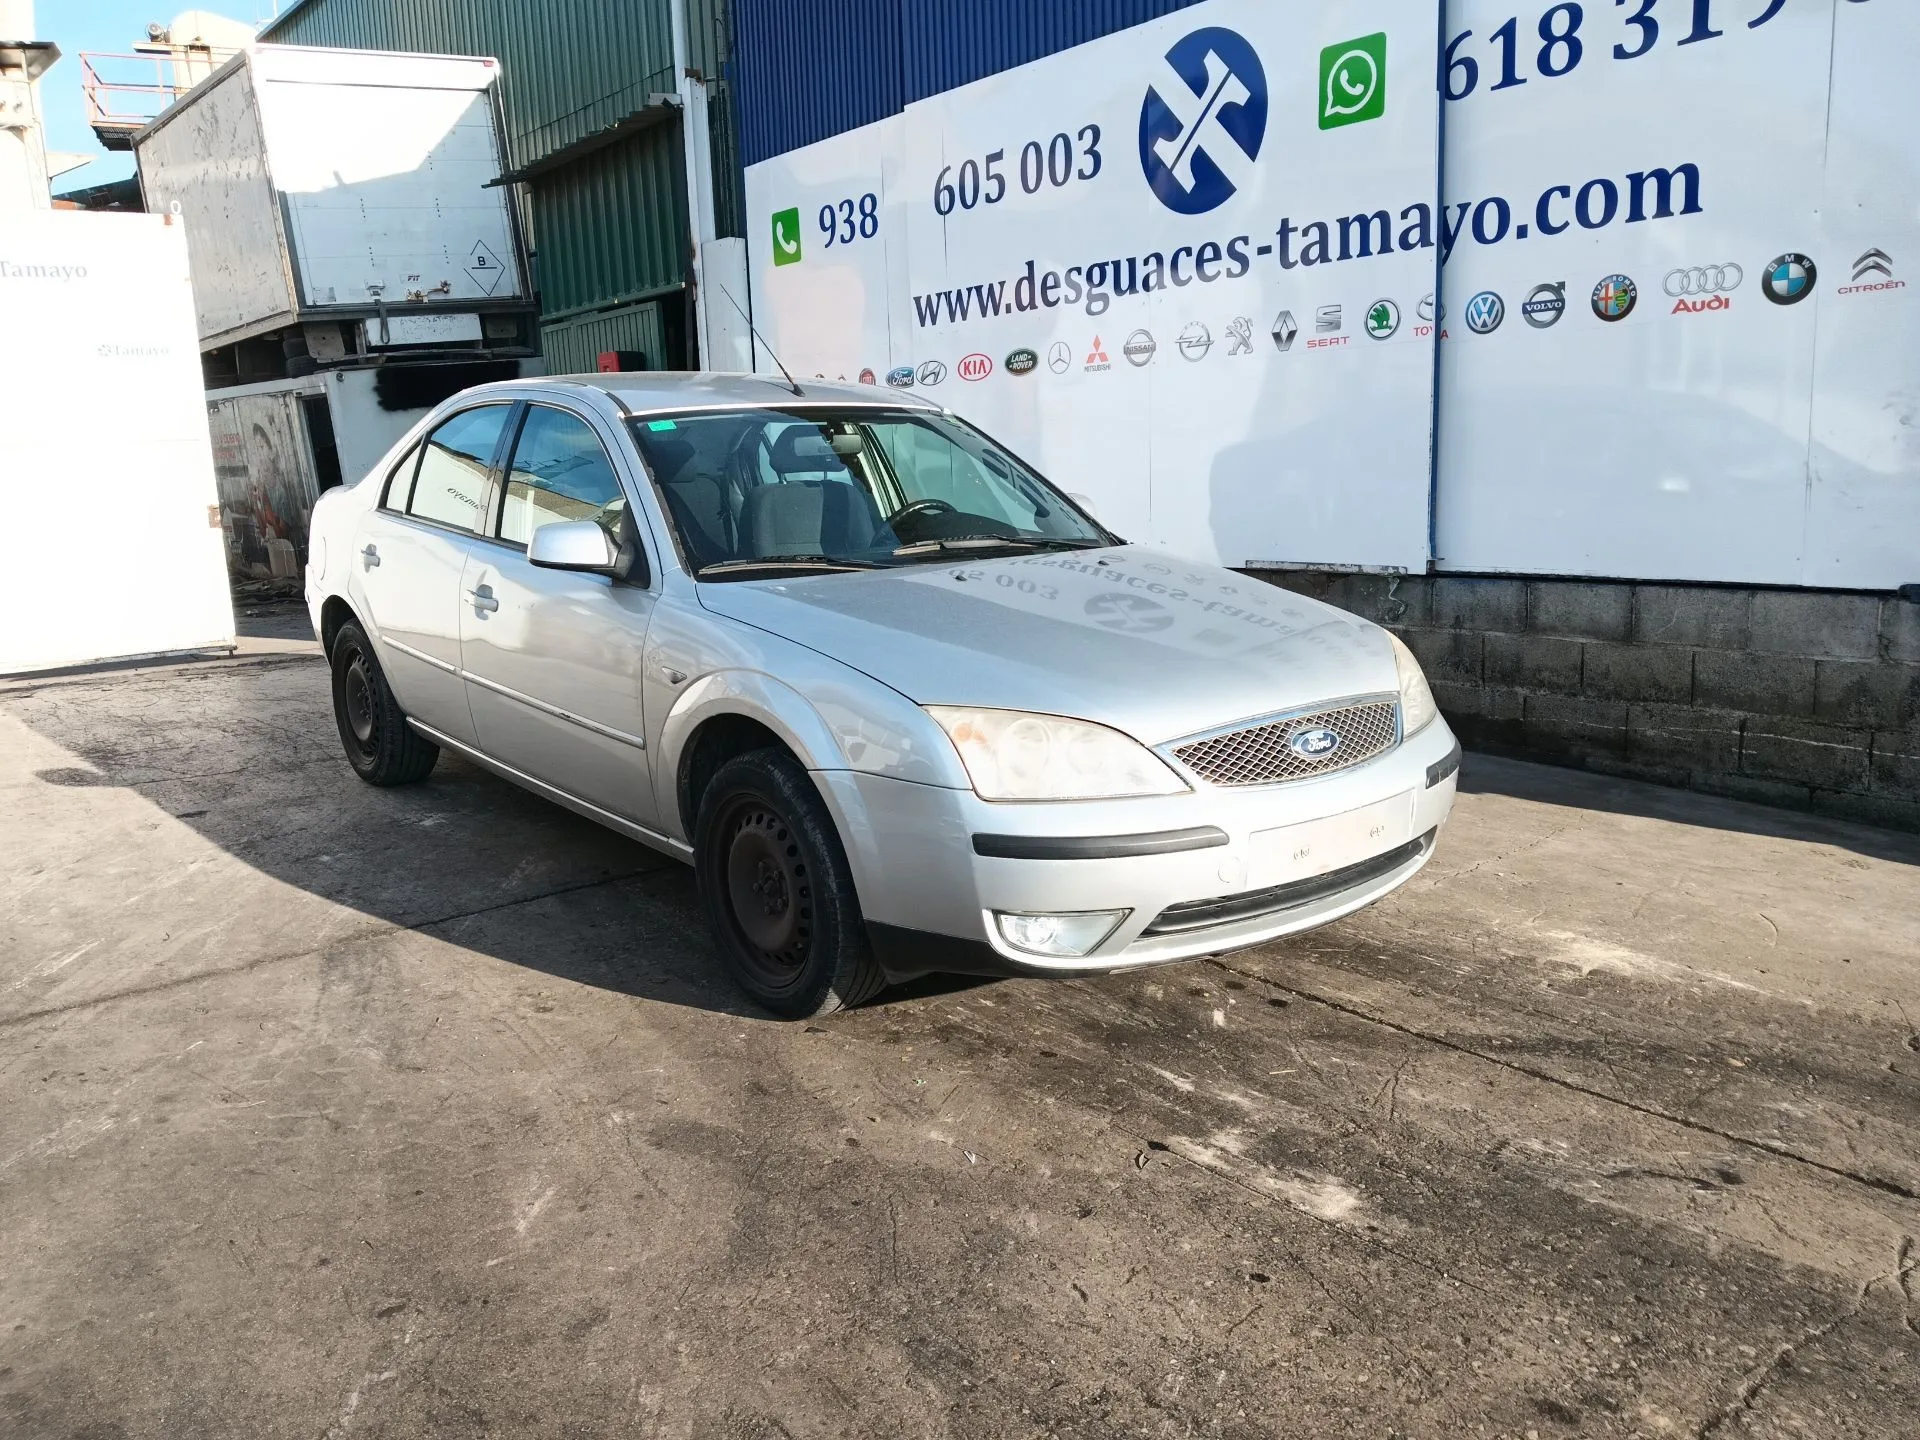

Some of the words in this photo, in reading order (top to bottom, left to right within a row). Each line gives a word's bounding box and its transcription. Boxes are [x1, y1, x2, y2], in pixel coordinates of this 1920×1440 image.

[1444, 2, 1584, 101] 618
[818, 192, 879, 249] 938
[934, 148, 1006, 216] 605
[1019, 123, 1102, 195] 003
[913, 162, 1704, 328] www.desguaces-tamayo.com
[477, 256, 486, 267] B
[1767, 254, 1812, 272] BMW
[0, 260, 88, 282] Tamayo
[1612, 275, 1636, 297] ROMEO
[1525, 301, 1562, 311] VOLVO
[1413, 326, 1449, 340] TOA
[1126, 344, 1153, 353] NISSAN
[1307, 336, 1350, 348] SEAT
[963, 360, 987, 376] KIA
[892, 370, 914, 385] Ford
[1307, 732, 1332, 752] Ford
